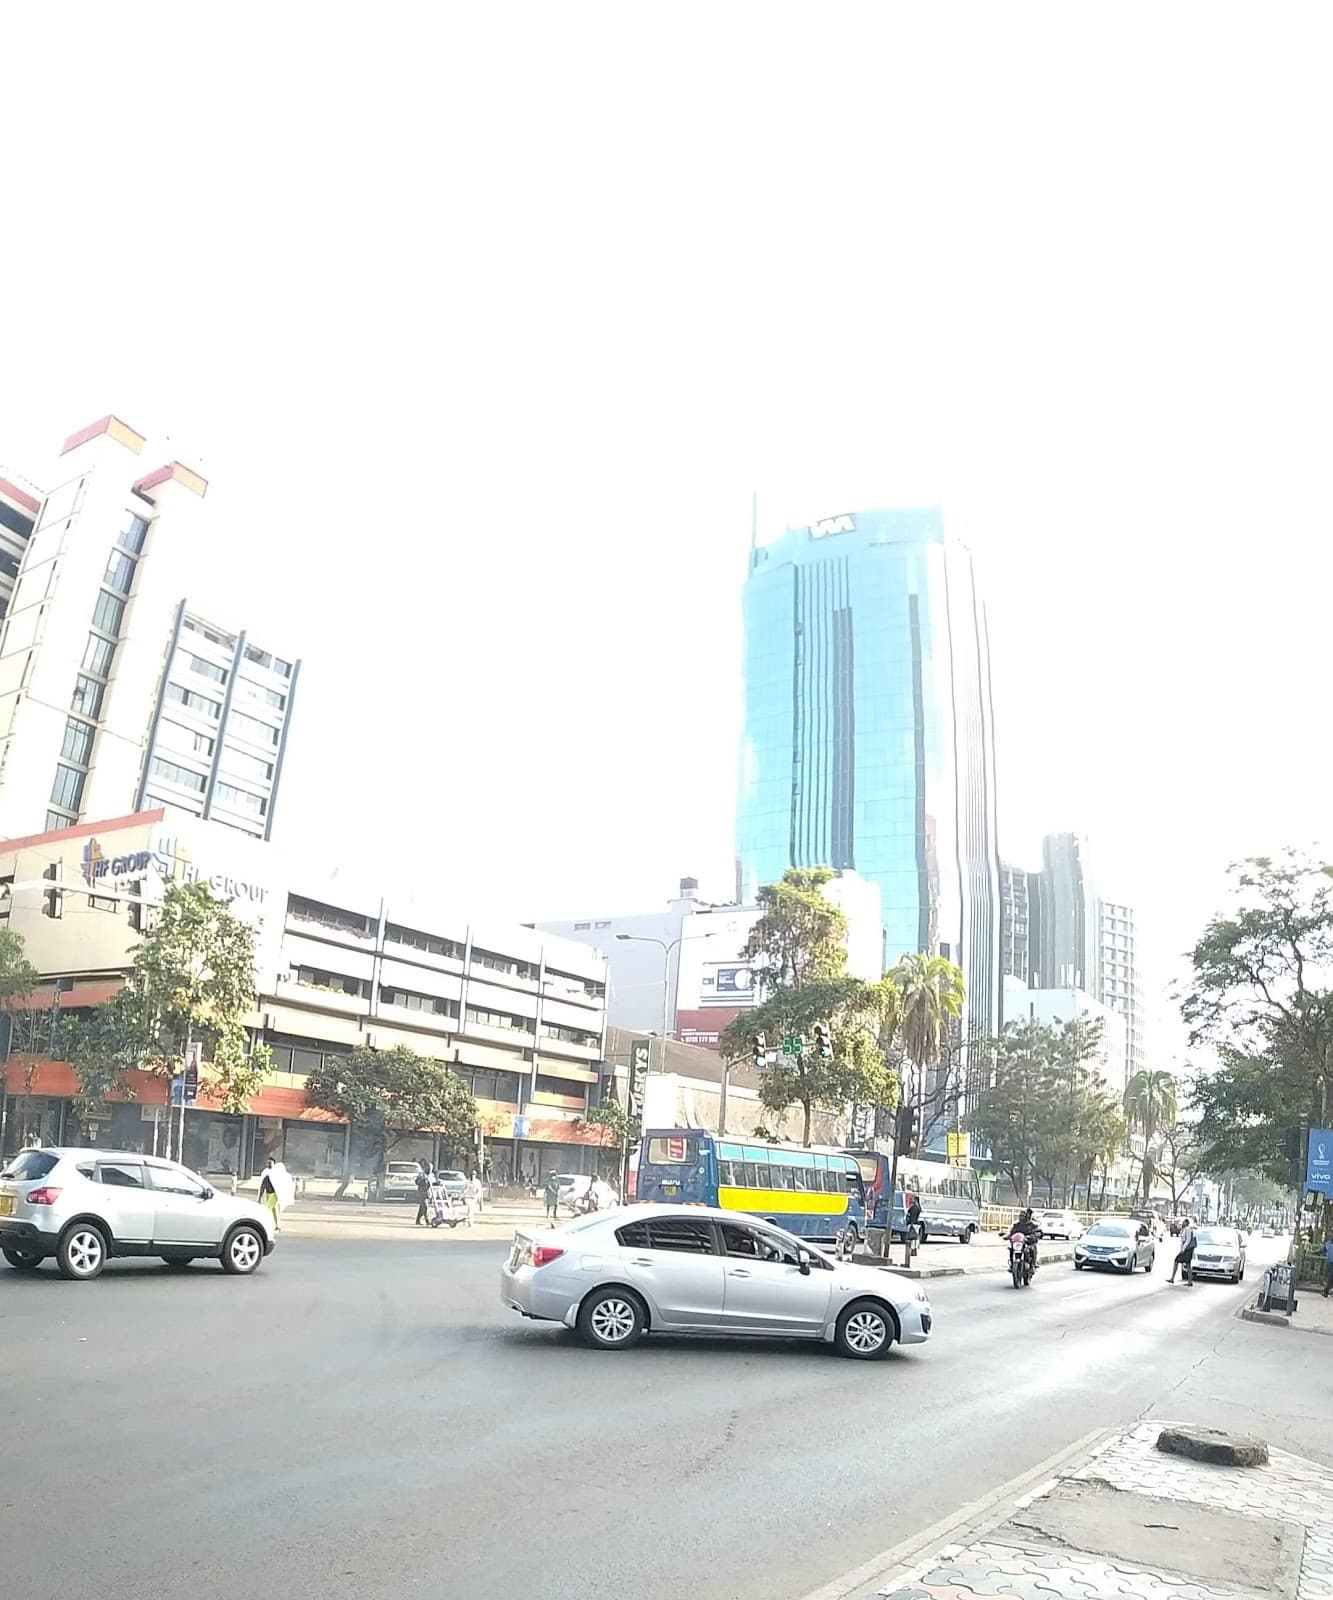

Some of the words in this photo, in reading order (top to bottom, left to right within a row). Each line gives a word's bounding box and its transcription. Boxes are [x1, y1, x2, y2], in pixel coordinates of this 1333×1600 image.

[95, 860, 110, 878] HF
[111, 851, 152, 876] GROUP
[783, 1036, 803, 1055] 55
[631, 1047, 648, 1116] TUSKYS
